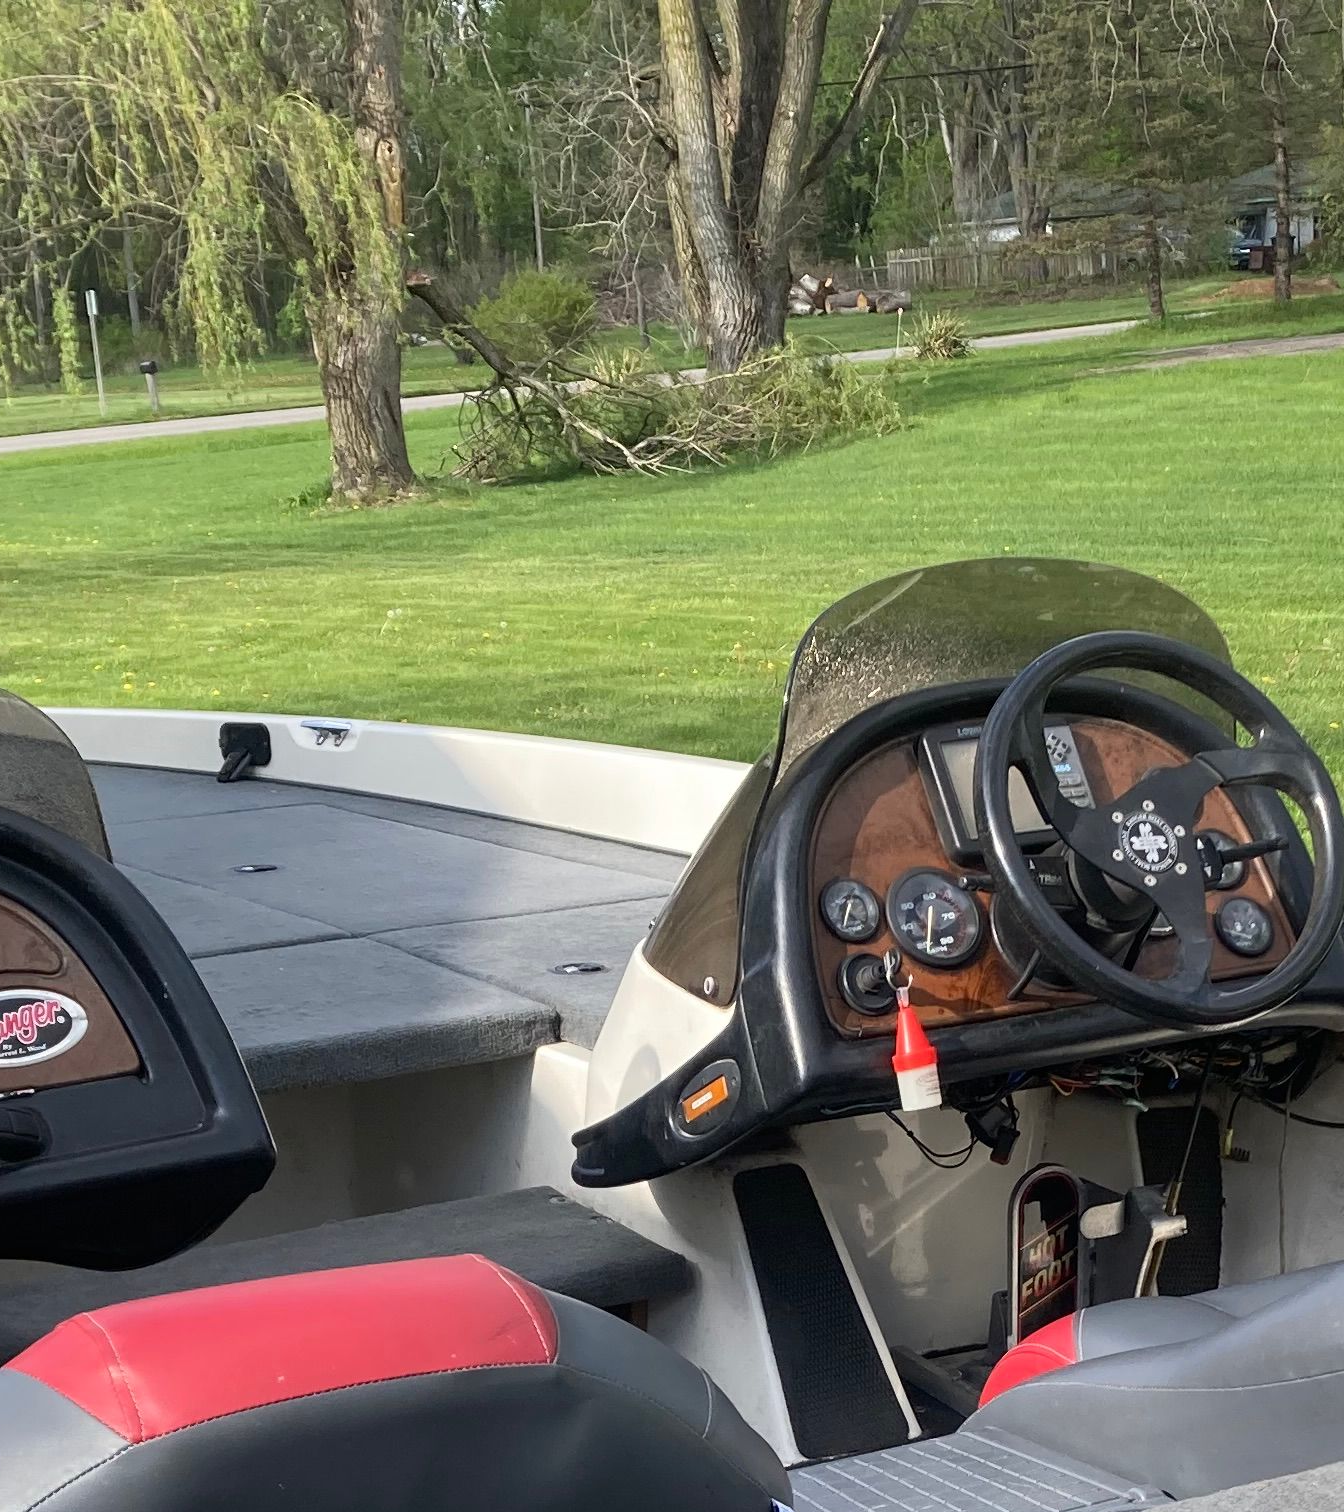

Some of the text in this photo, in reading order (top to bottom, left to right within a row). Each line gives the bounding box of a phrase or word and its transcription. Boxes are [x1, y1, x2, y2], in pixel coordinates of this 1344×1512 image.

[941, 911, 955, 920] 70
[1029, 1224, 1070, 1263] HOT
[1021, 1251, 1075, 1305] FOOT
